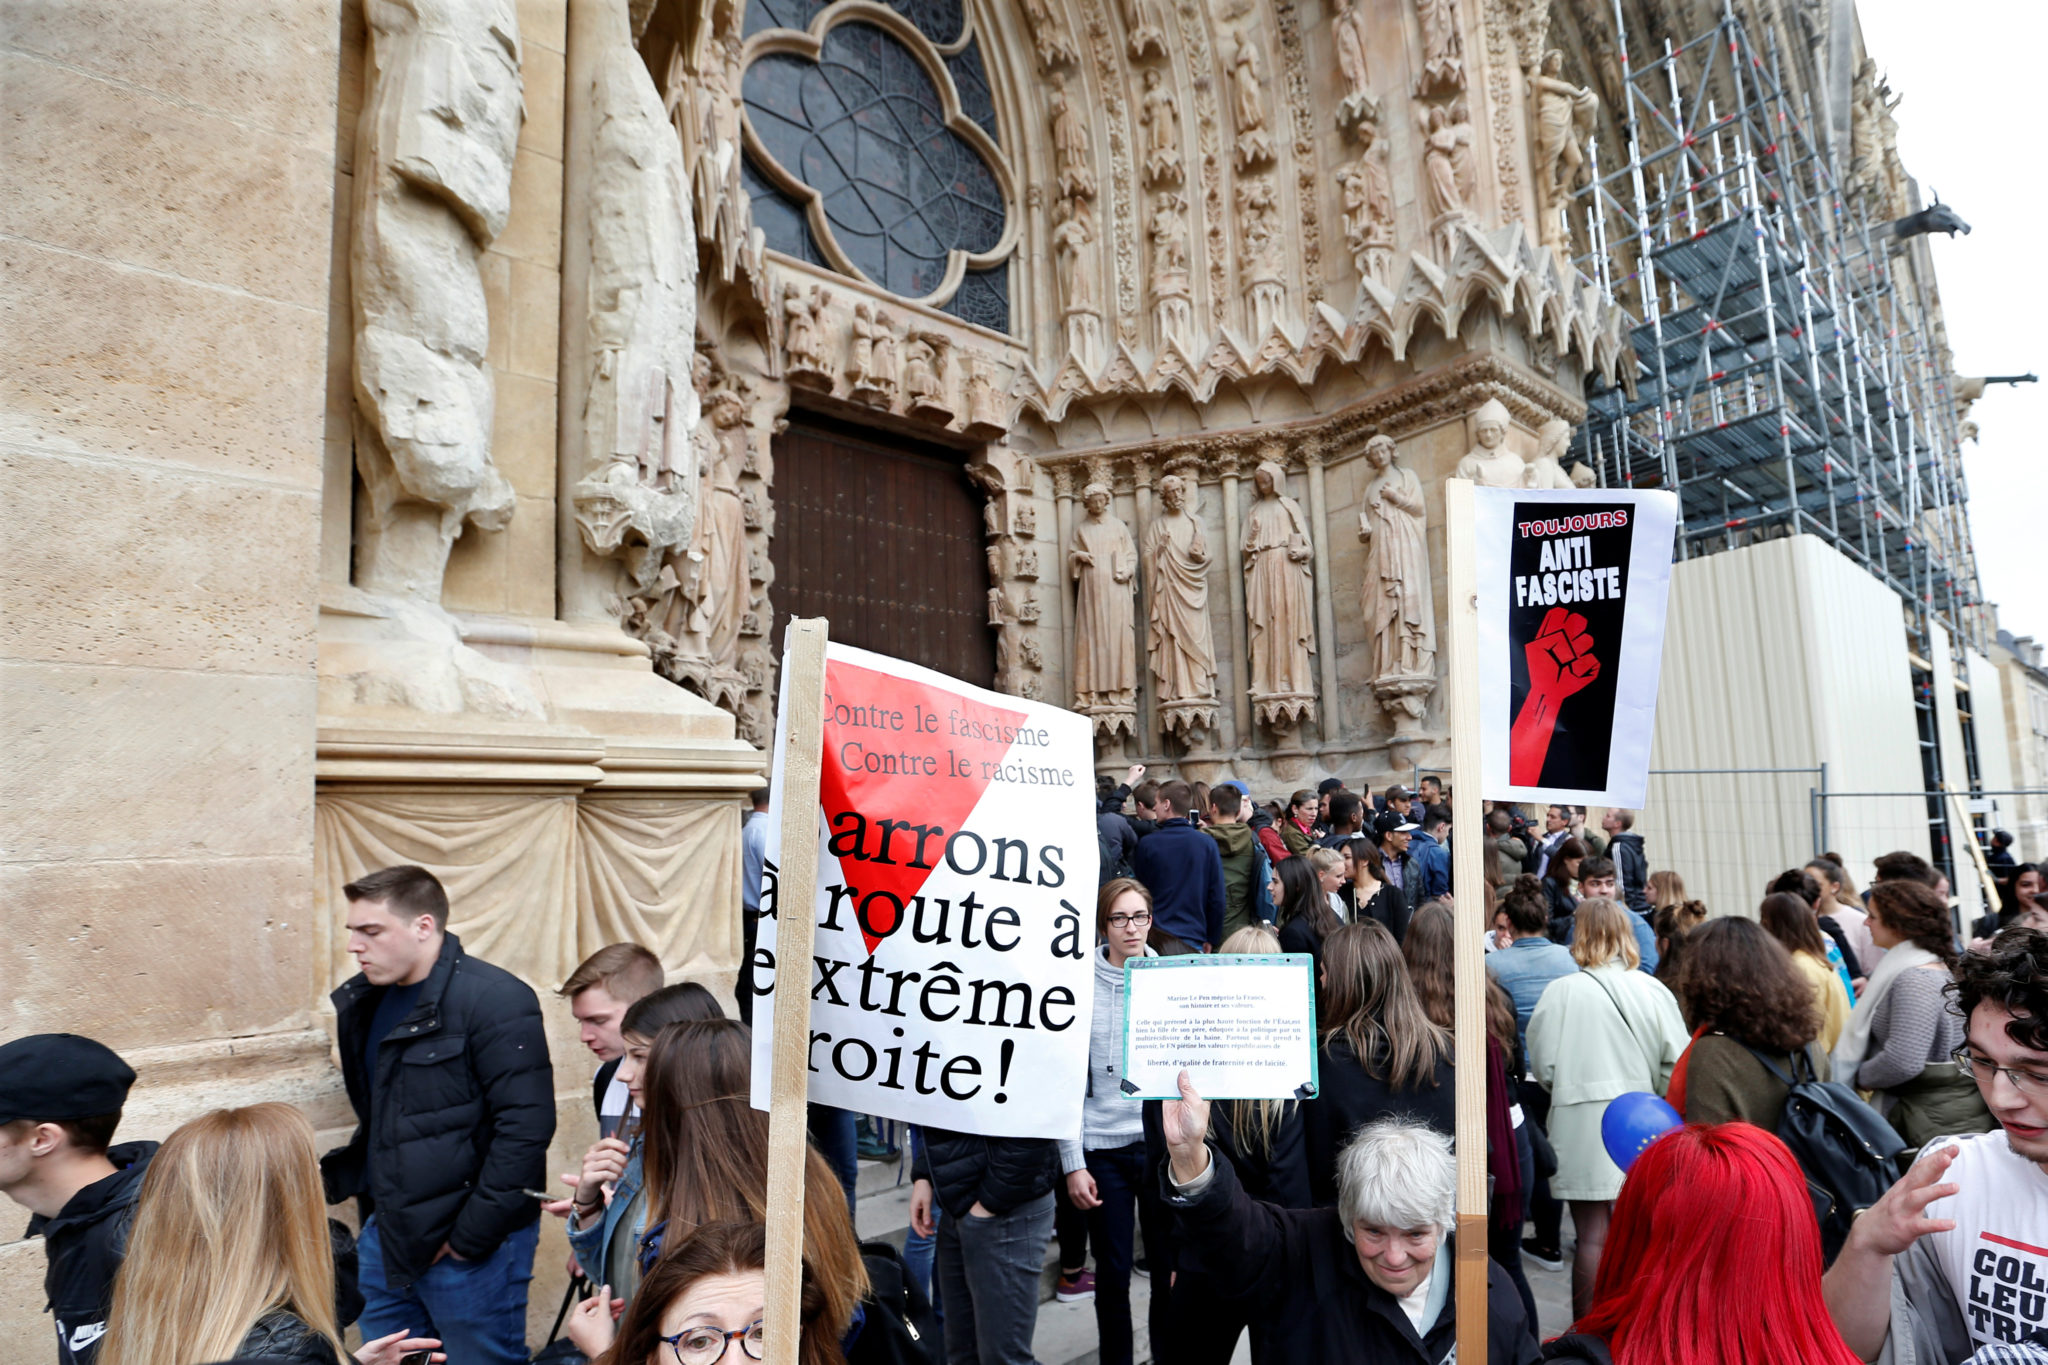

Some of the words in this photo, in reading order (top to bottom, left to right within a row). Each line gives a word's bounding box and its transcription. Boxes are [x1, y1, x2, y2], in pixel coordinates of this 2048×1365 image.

[1518, 509, 1628, 537] TOUJOURS
[1539, 535, 1592, 572] ANTI
[1515, 566, 1621, 607] FASCISTE
[914, 704, 939, 733] le
[948, 708, 1050, 747] fascisme
[840, 741, 938, 776] Contre
[947, 749, 972, 778] le
[981, 758, 1075, 787] racisme
[820, 810, 1066, 889] arrons
[818, 883, 1021, 952] route
[1050, 899, 1085, 960] à
[1969, 1274, 2047, 1322] LEU
